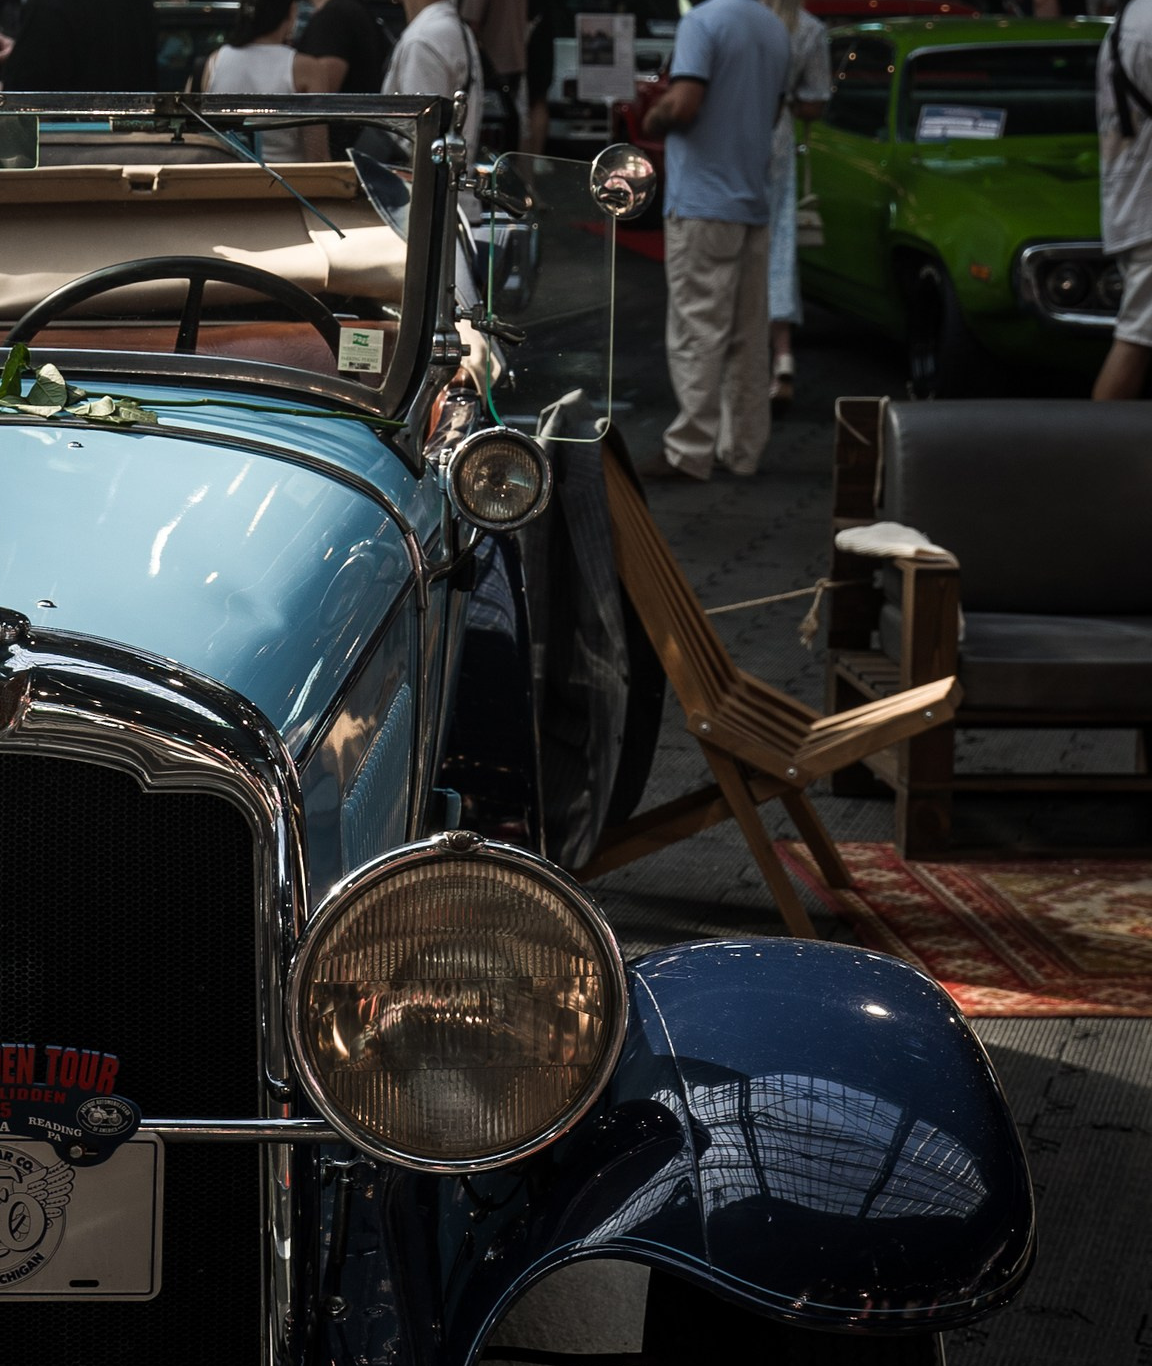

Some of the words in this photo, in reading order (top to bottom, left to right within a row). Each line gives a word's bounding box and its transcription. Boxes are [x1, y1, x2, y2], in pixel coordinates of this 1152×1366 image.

[45, 1045, 120, 1096] TOUR
[28, 1116, 83, 1138] READING
[47, 1130, 62, 1142] PA
